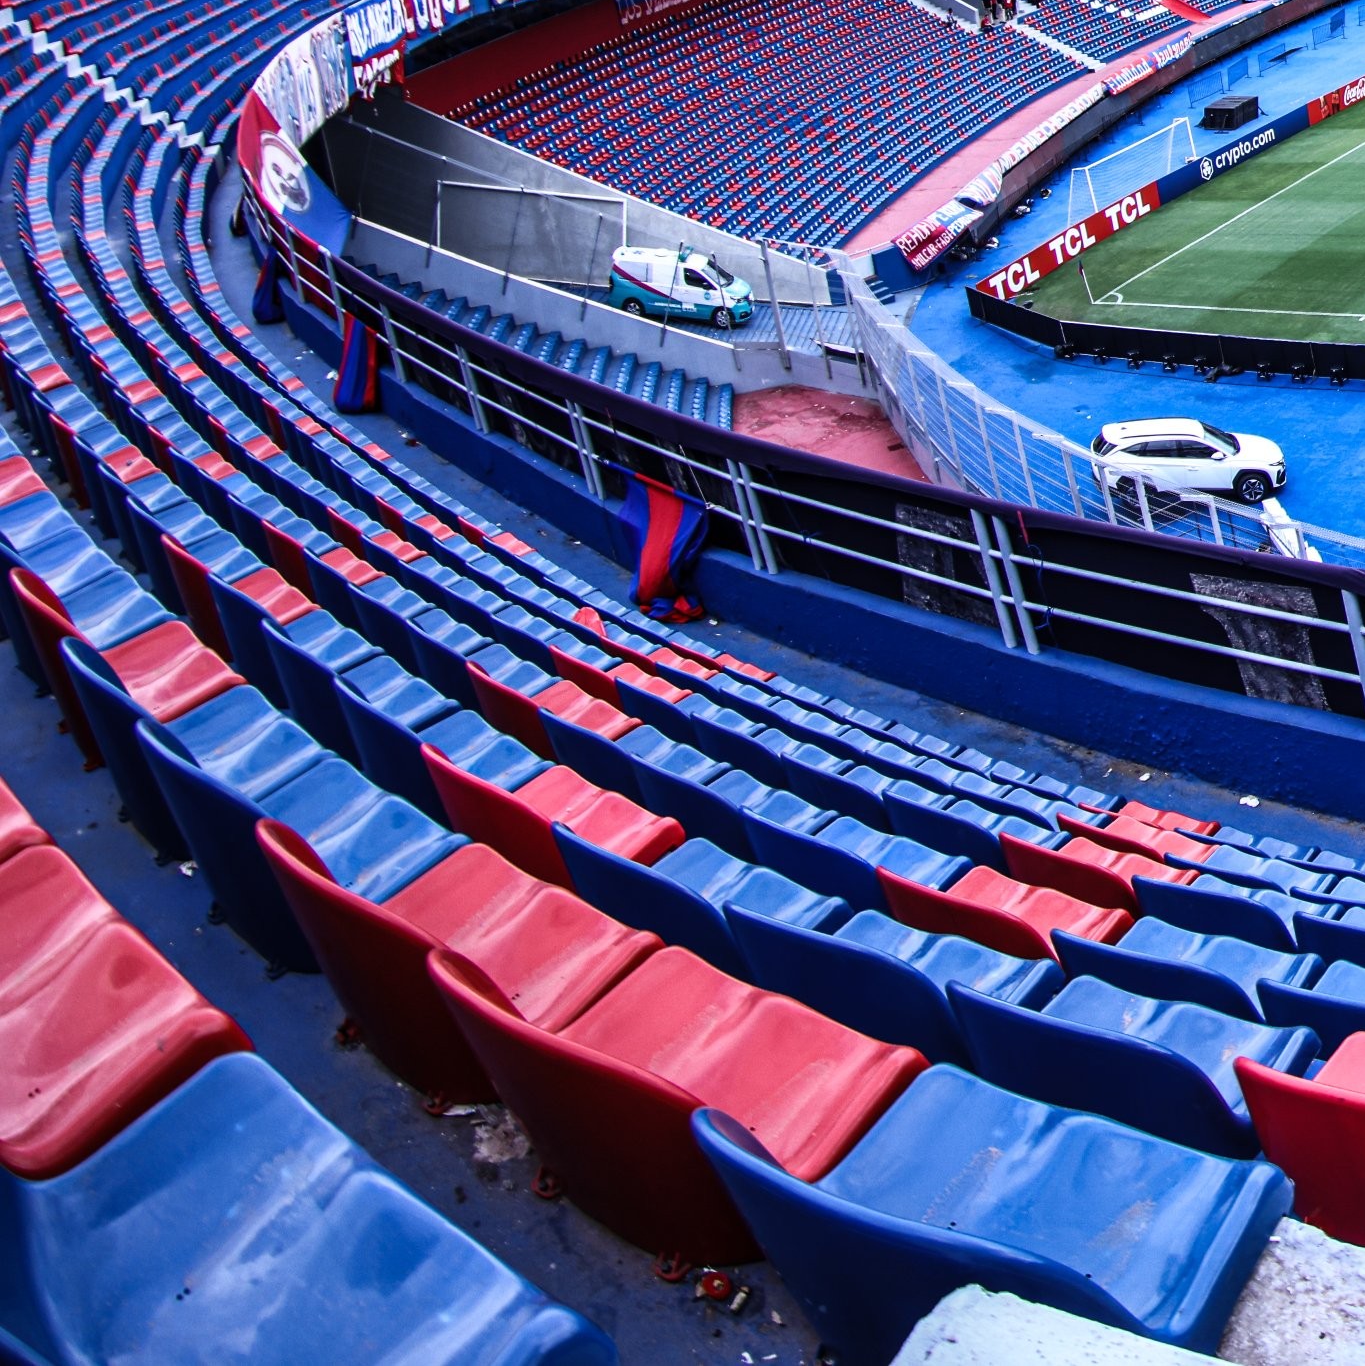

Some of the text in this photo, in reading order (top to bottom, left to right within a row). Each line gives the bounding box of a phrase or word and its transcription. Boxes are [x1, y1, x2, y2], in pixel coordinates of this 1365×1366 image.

[1215, 128, 1276, 168] crypto.com
[989, 191, 1151, 300] TCL TCL TCL
